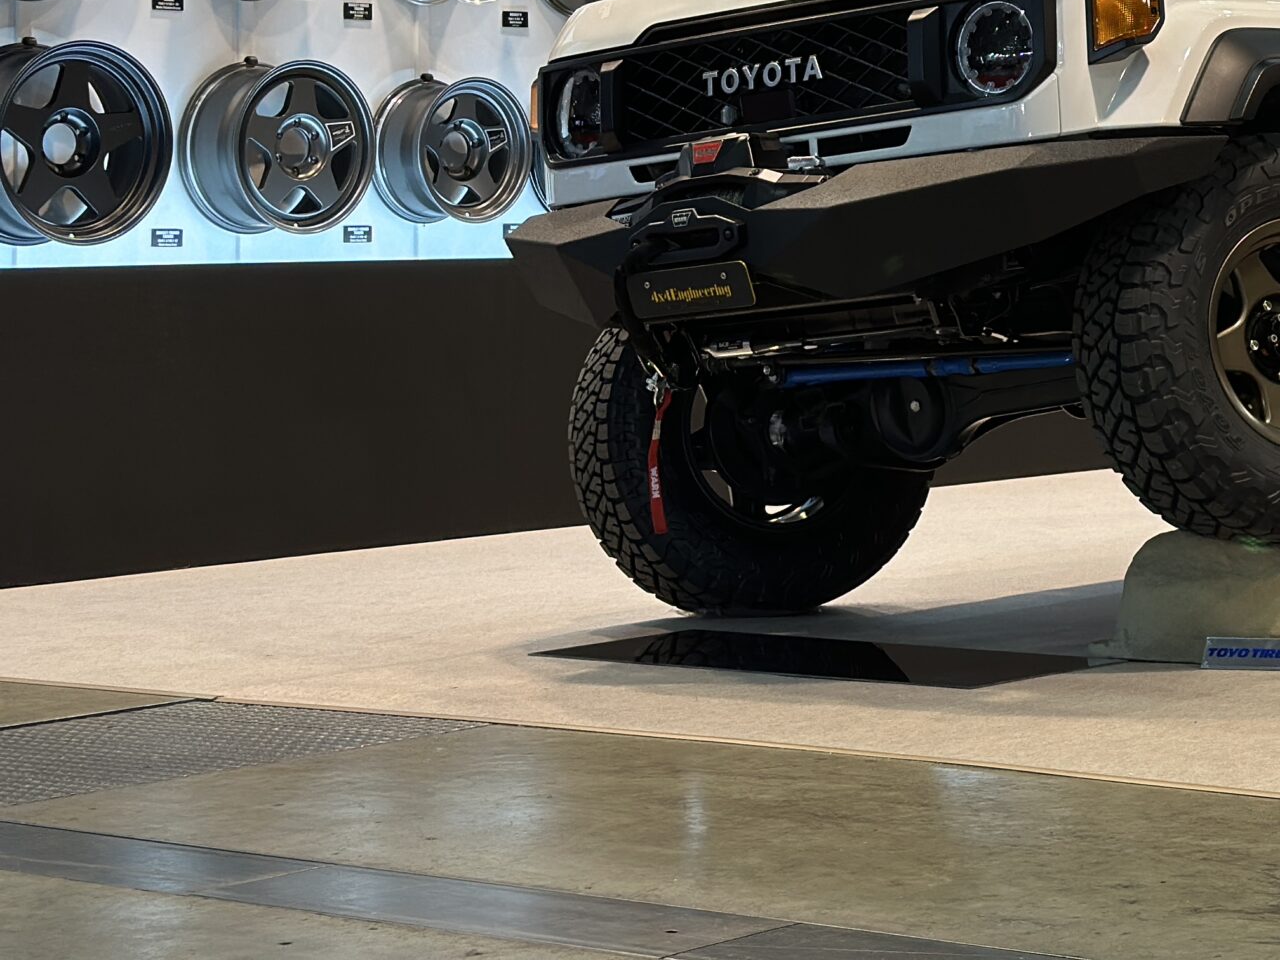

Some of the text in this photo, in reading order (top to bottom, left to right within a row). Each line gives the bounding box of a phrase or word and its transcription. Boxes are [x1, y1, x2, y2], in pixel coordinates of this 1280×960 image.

[702, 54, 823, 97] TOYOTA
[651, 283, 732, 303] 4x4Engineering
[1208, 647, 1250, 658] TOYO
